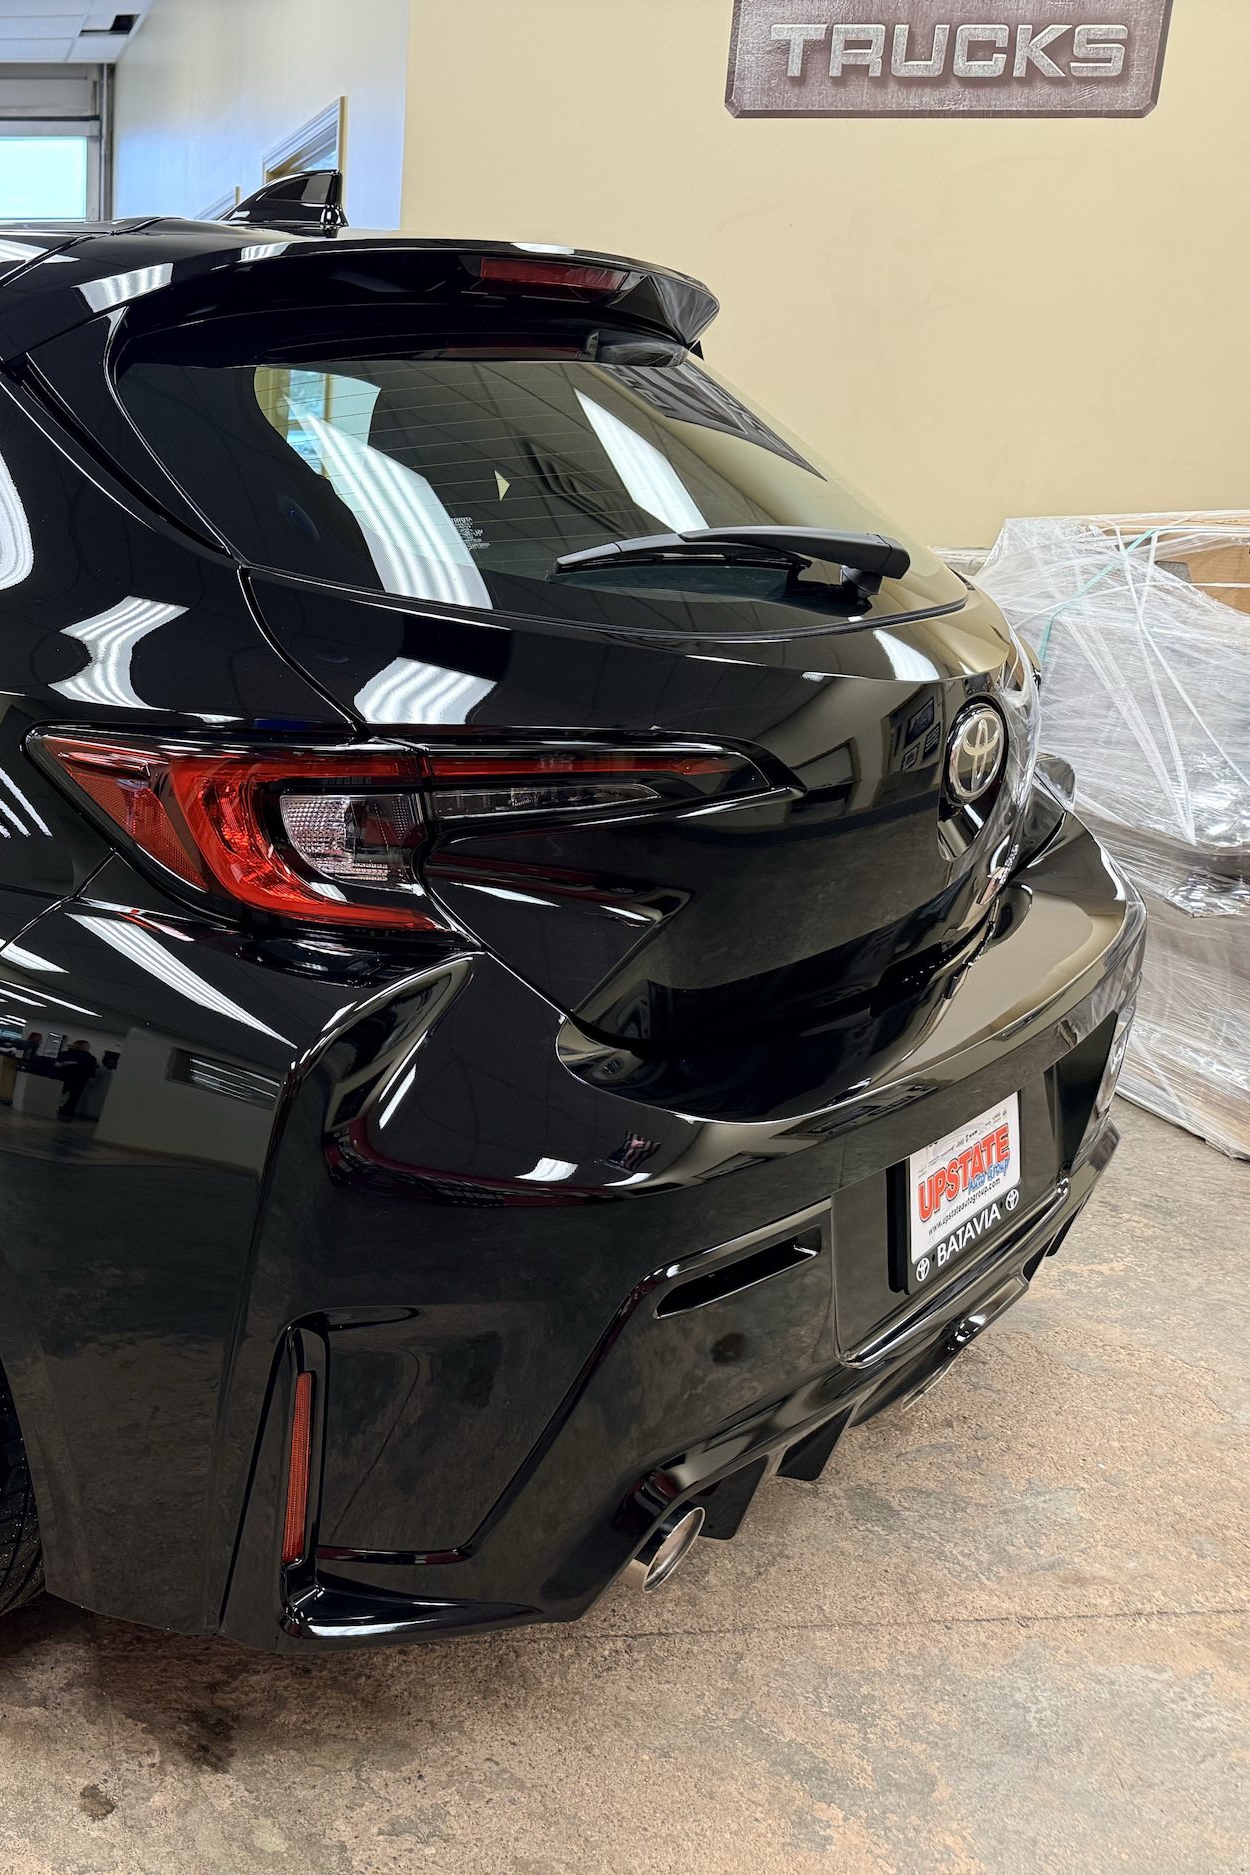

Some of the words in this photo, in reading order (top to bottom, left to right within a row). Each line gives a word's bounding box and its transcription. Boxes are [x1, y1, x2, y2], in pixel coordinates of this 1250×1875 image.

[770, 23, 1129, 78] TRUCKS
[917, 1122, 1011, 1223] UPSTATE
[937, 1203, 1002, 1268] BATAVIA
